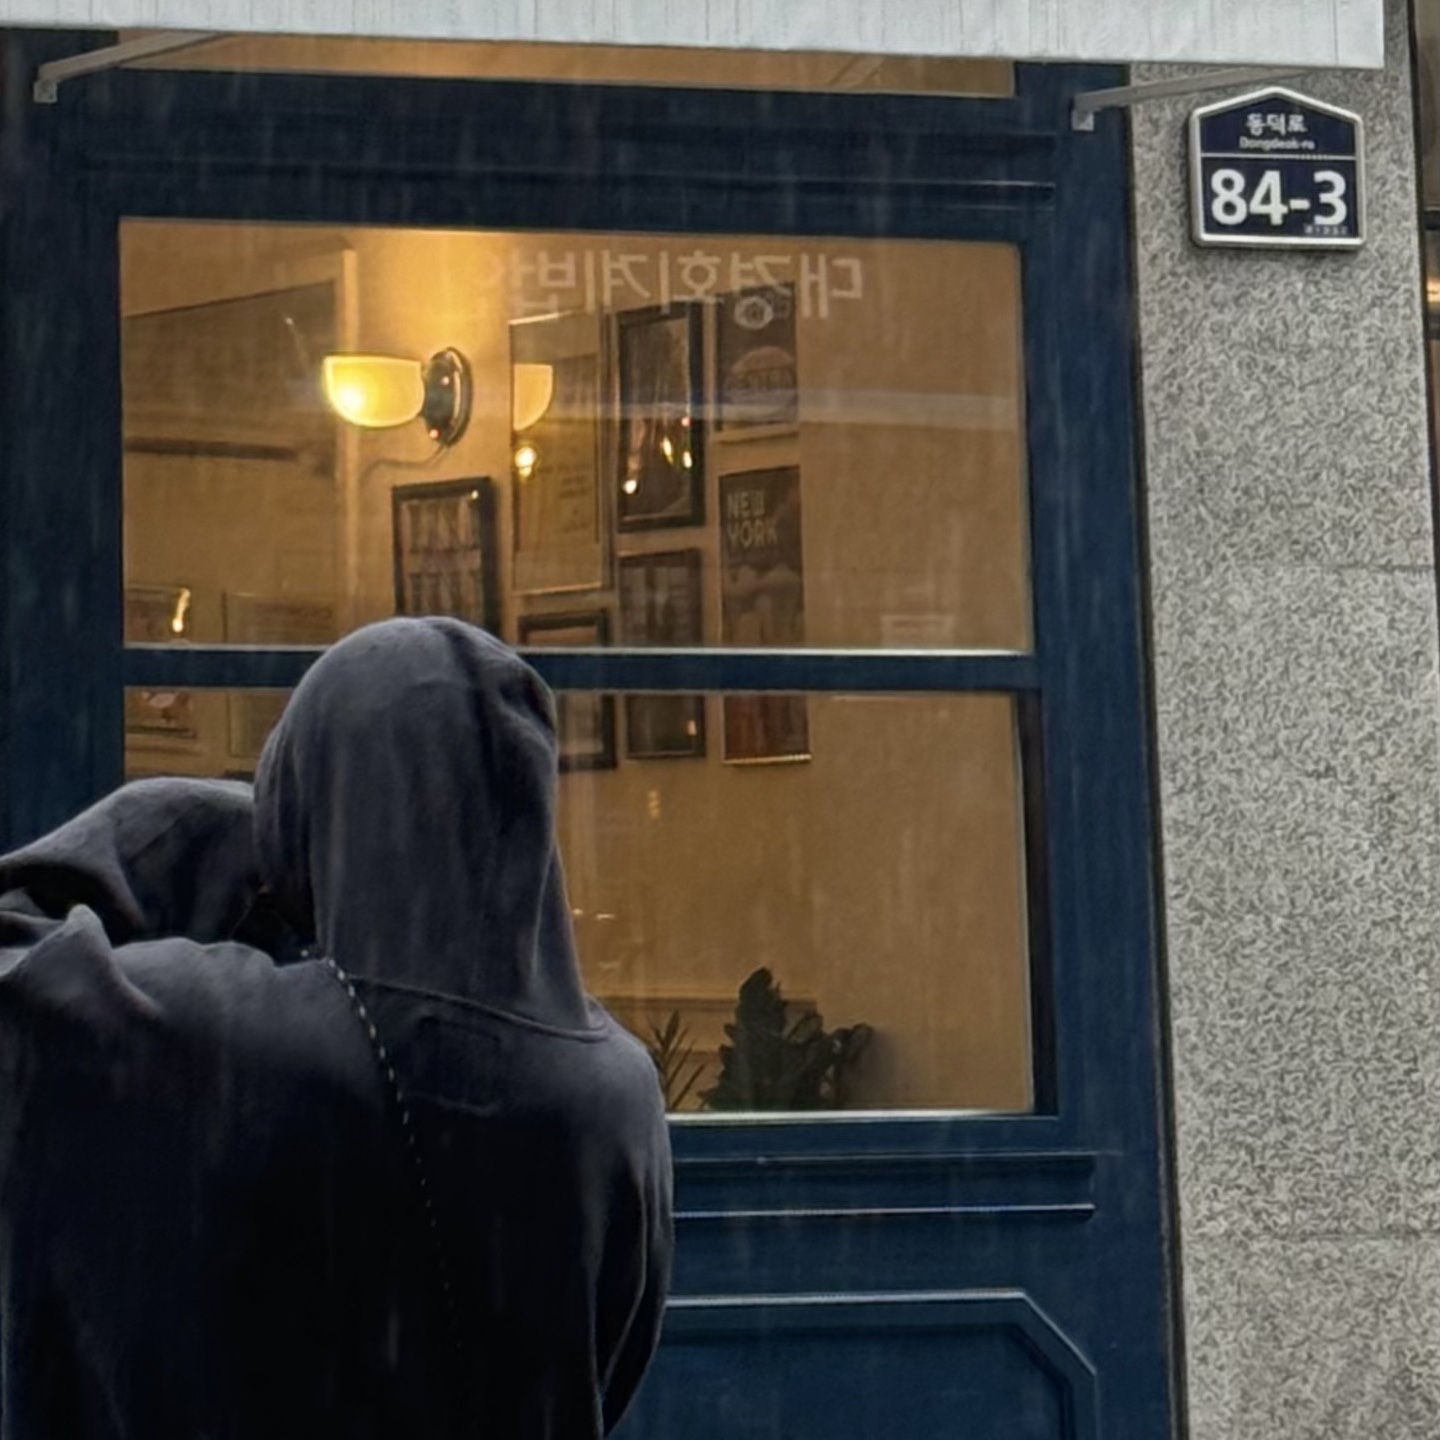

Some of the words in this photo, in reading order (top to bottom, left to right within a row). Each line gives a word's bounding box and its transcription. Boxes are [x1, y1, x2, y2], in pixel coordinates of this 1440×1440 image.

[1246, 113, 1308, 135] 동덕로
[1211, 168, 1347, 226] 84-3
[727, 490, 765, 518] NEW
[727, 519, 778, 547] YORK
